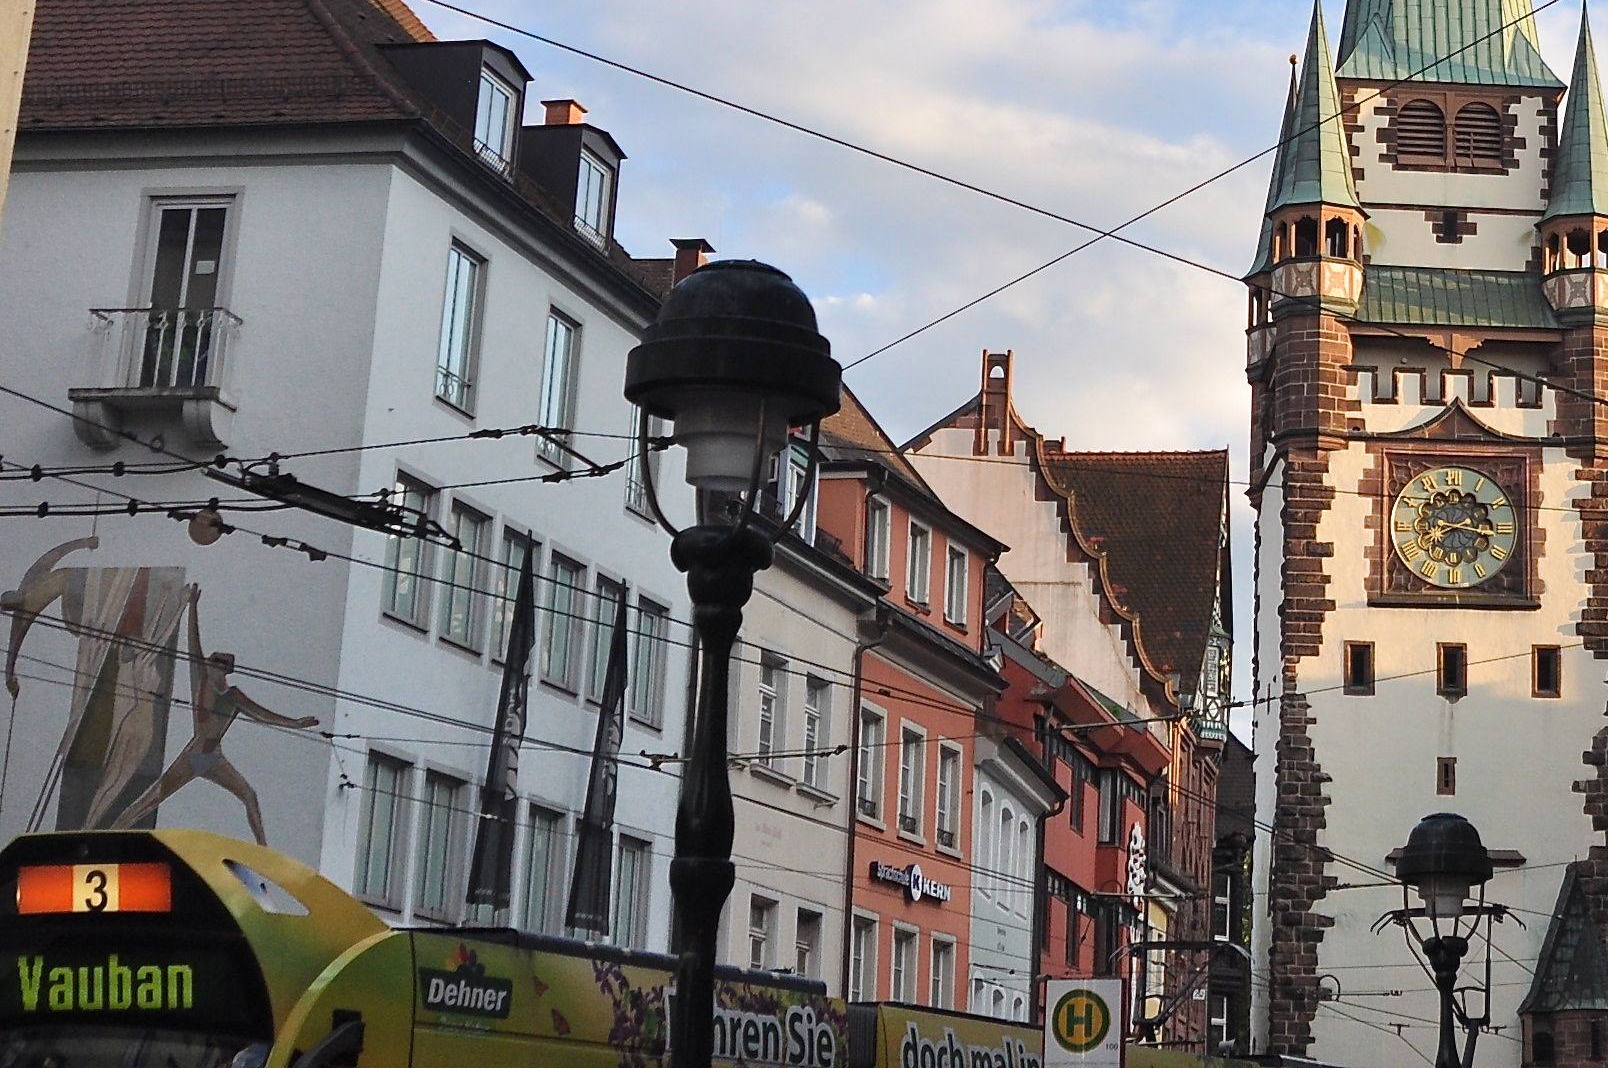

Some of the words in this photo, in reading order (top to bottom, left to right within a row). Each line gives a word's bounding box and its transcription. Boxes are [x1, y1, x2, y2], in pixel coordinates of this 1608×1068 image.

[85, 870, 108, 912] 3
[923, 878, 951, 901] KERN
[17, 953, 194, 1012] Vauban
[427, 978, 507, 1011] Dehner
[788, 1012, 833, 1067] Sie
[1066, 1003, 1093, 1038] H
[903, 1027, 964, 1068] doch
